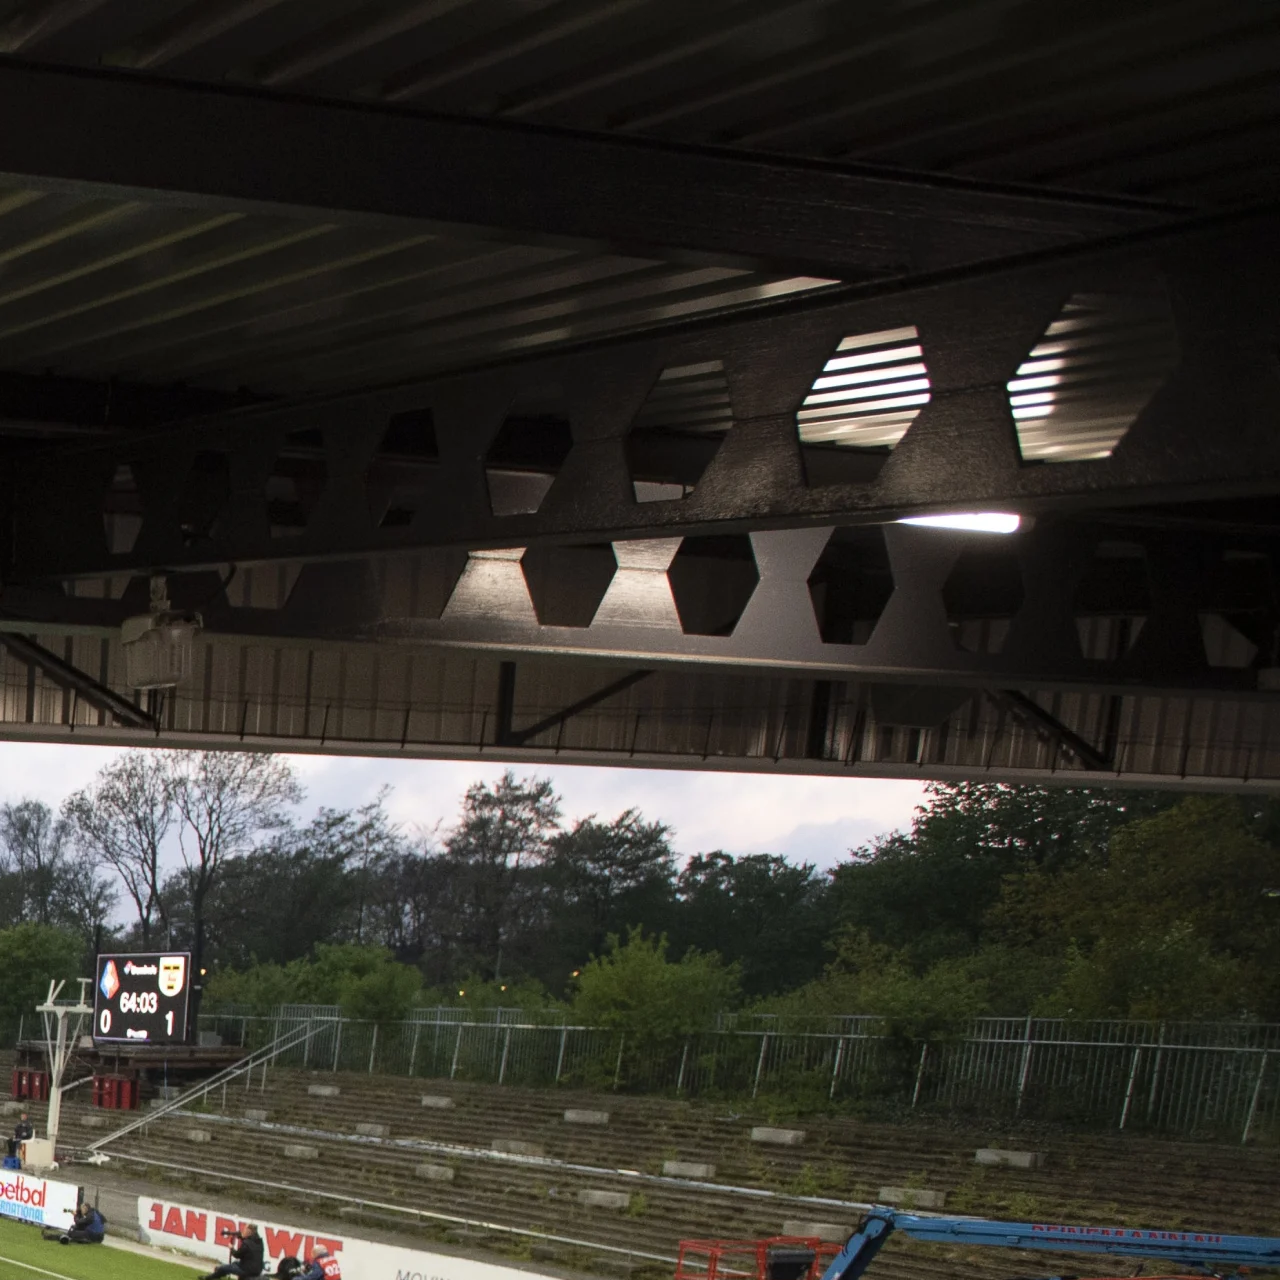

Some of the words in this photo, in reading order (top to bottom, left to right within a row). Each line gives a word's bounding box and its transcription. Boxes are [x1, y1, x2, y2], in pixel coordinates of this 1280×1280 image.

[120, 992, 157, 1013] 64:03
[100, 1009, 111, 1033] 0
[165, 1011, 174, 1036] 1
[149, 1203, 207, 1242] JAN
